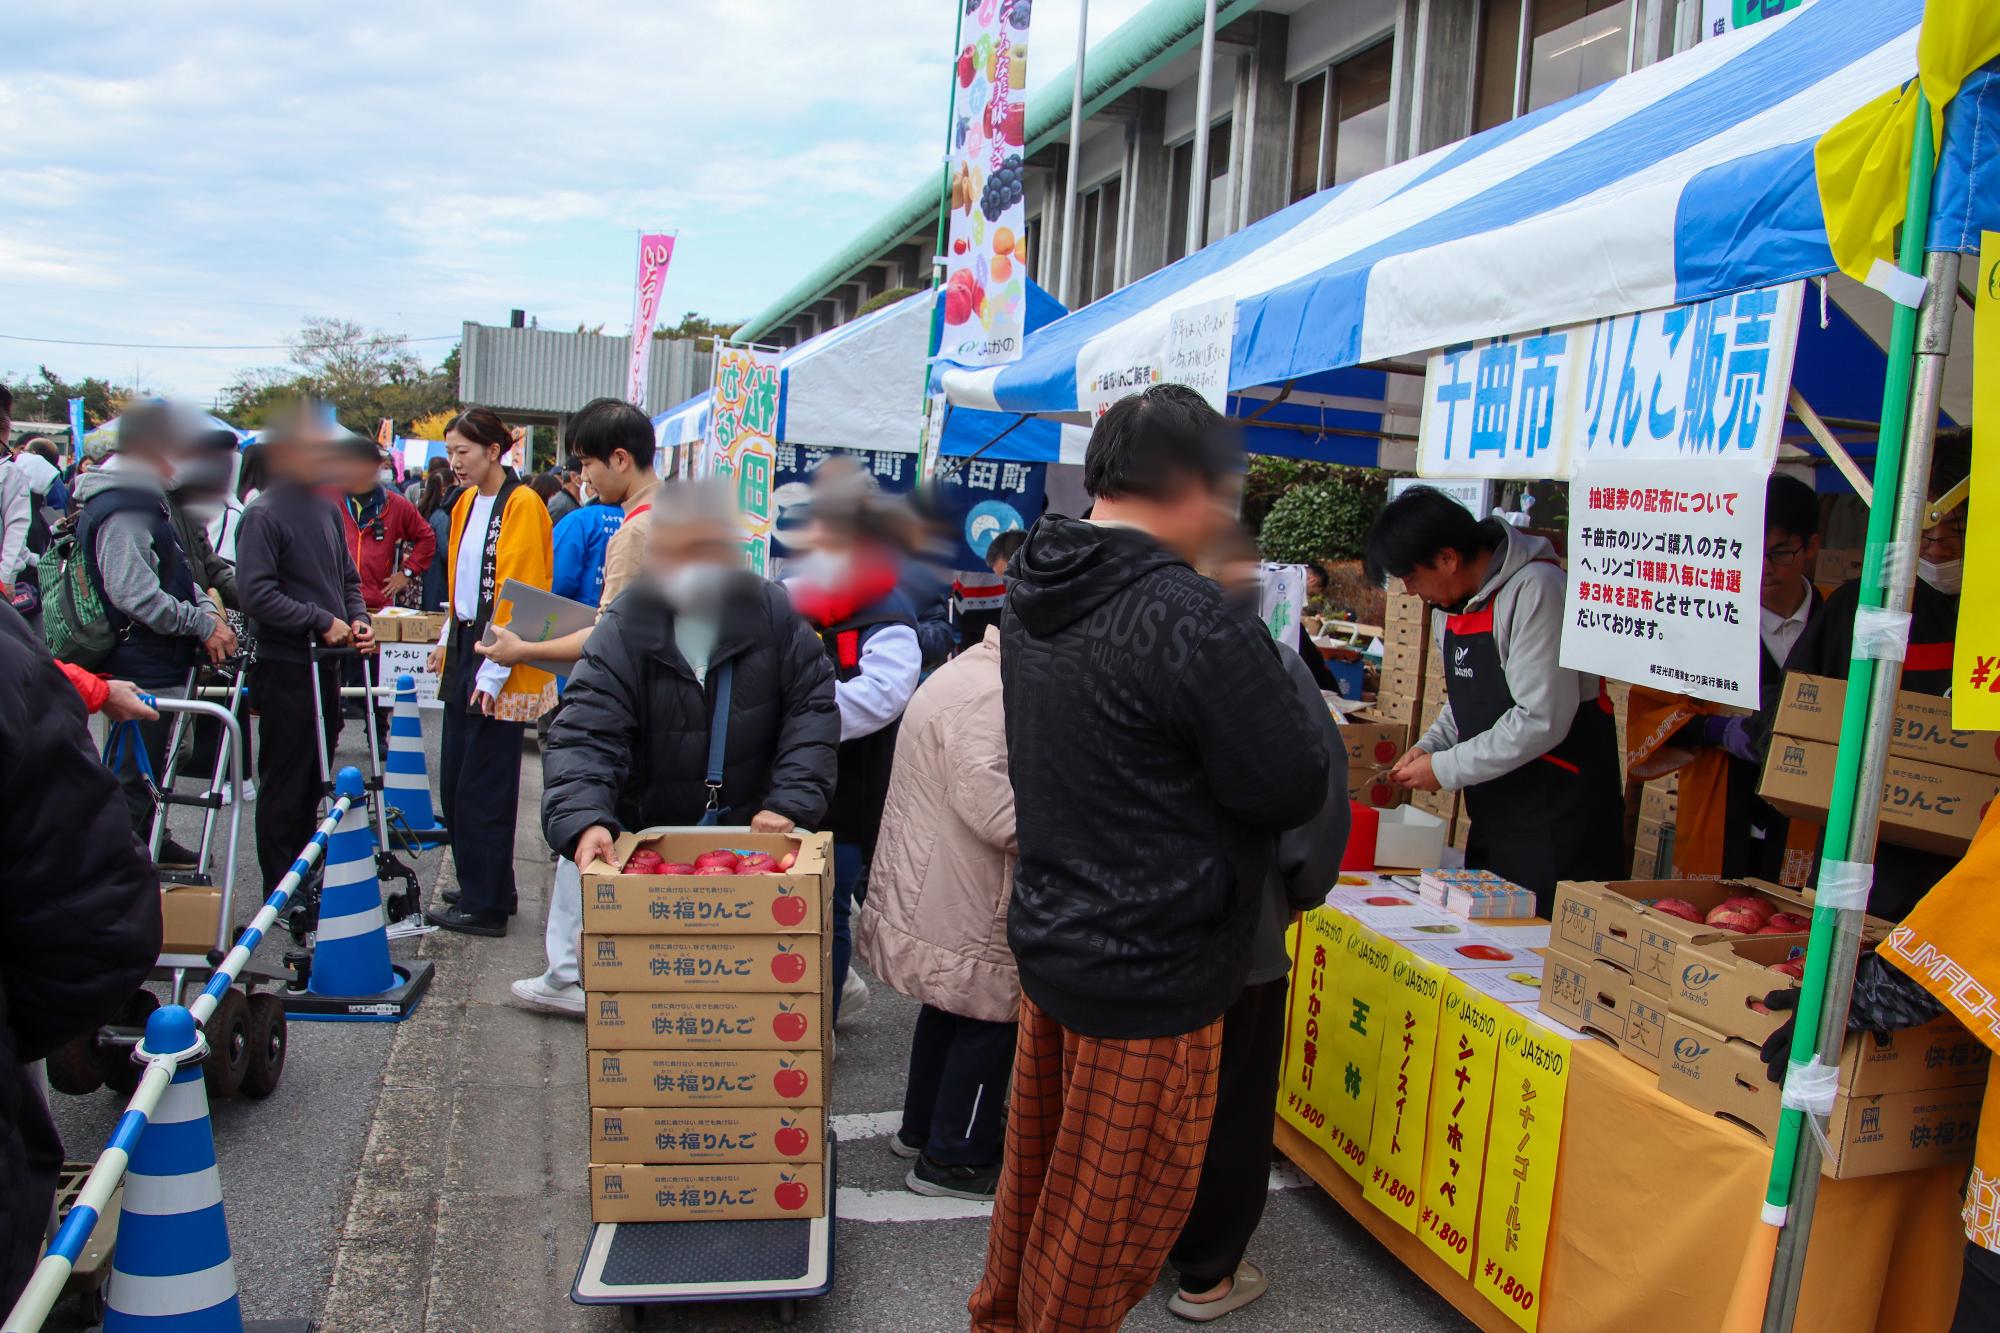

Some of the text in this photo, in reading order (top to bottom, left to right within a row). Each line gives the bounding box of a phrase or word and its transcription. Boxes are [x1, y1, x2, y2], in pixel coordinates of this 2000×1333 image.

[991, 0, 1015, 172] イムな美味しさ
[1097, 366, 1150, 391] 千曲市りんご販売
[1436, 288, 1779, 460] 千曲市 りんご販売
[1589, 487, 1738, 516] 抽選券の配布について
[1581, 527, 1742, 560] 千曲市のリンゴ購入の方々
[482, 516, 502, 603] 長野県 千曲市
[1581, 557, 1742, 594] へ、リンゴ1箱購入毎に抽選
[1579, 580, 1739, 625] 券3枚を配布とさせていた
[1577, 608, 1664, 641] だいております。
[385, 650, 419, 659] サンふじ
[1650, 664, 1739, 692] 横芝光町産業まつり実行委員会
[1883, 784, 1961, 816] りんご
[649, 900, 754, 920] 快福りんご
[1315, 914, 1342, 945] JAながの
[1648, 933, 1669, 951] 規格
[649, 957, 754, 976] 快福りんご
[1357, 942, 1389, 973] JAながの
[1650, 953, 1666, 979] 大
[1405, 969, 1438, 999] JAながの
[1680, 990, 1709, 1007] JAながの
[652, 1016, 755, 1035] 快福りんご
[1302, 944, 1327, 1091] あいかの香り
[1459, 1000, 1496, 1038] JAながの
[1637, 1006, 1658, 1023] 規格
[1633, 1021, 1650, 1047] 大
[1520, 1039, 1563, 1076] JAながの
[1672, 1063, 1701, 1080] JAながの
[653, 1073, 756, 1092] 快福りんご
[1390, 1010, 1416, 1155] シナノスイート
[1440, 1033, 1475, 1208] シナノホッペ
[656, 1132, 757, 1151] 快福りんご
[1504, 1078, 1536, 1252] シナノゴールド
[656, 1188, 757, 1207] 快福りんご
